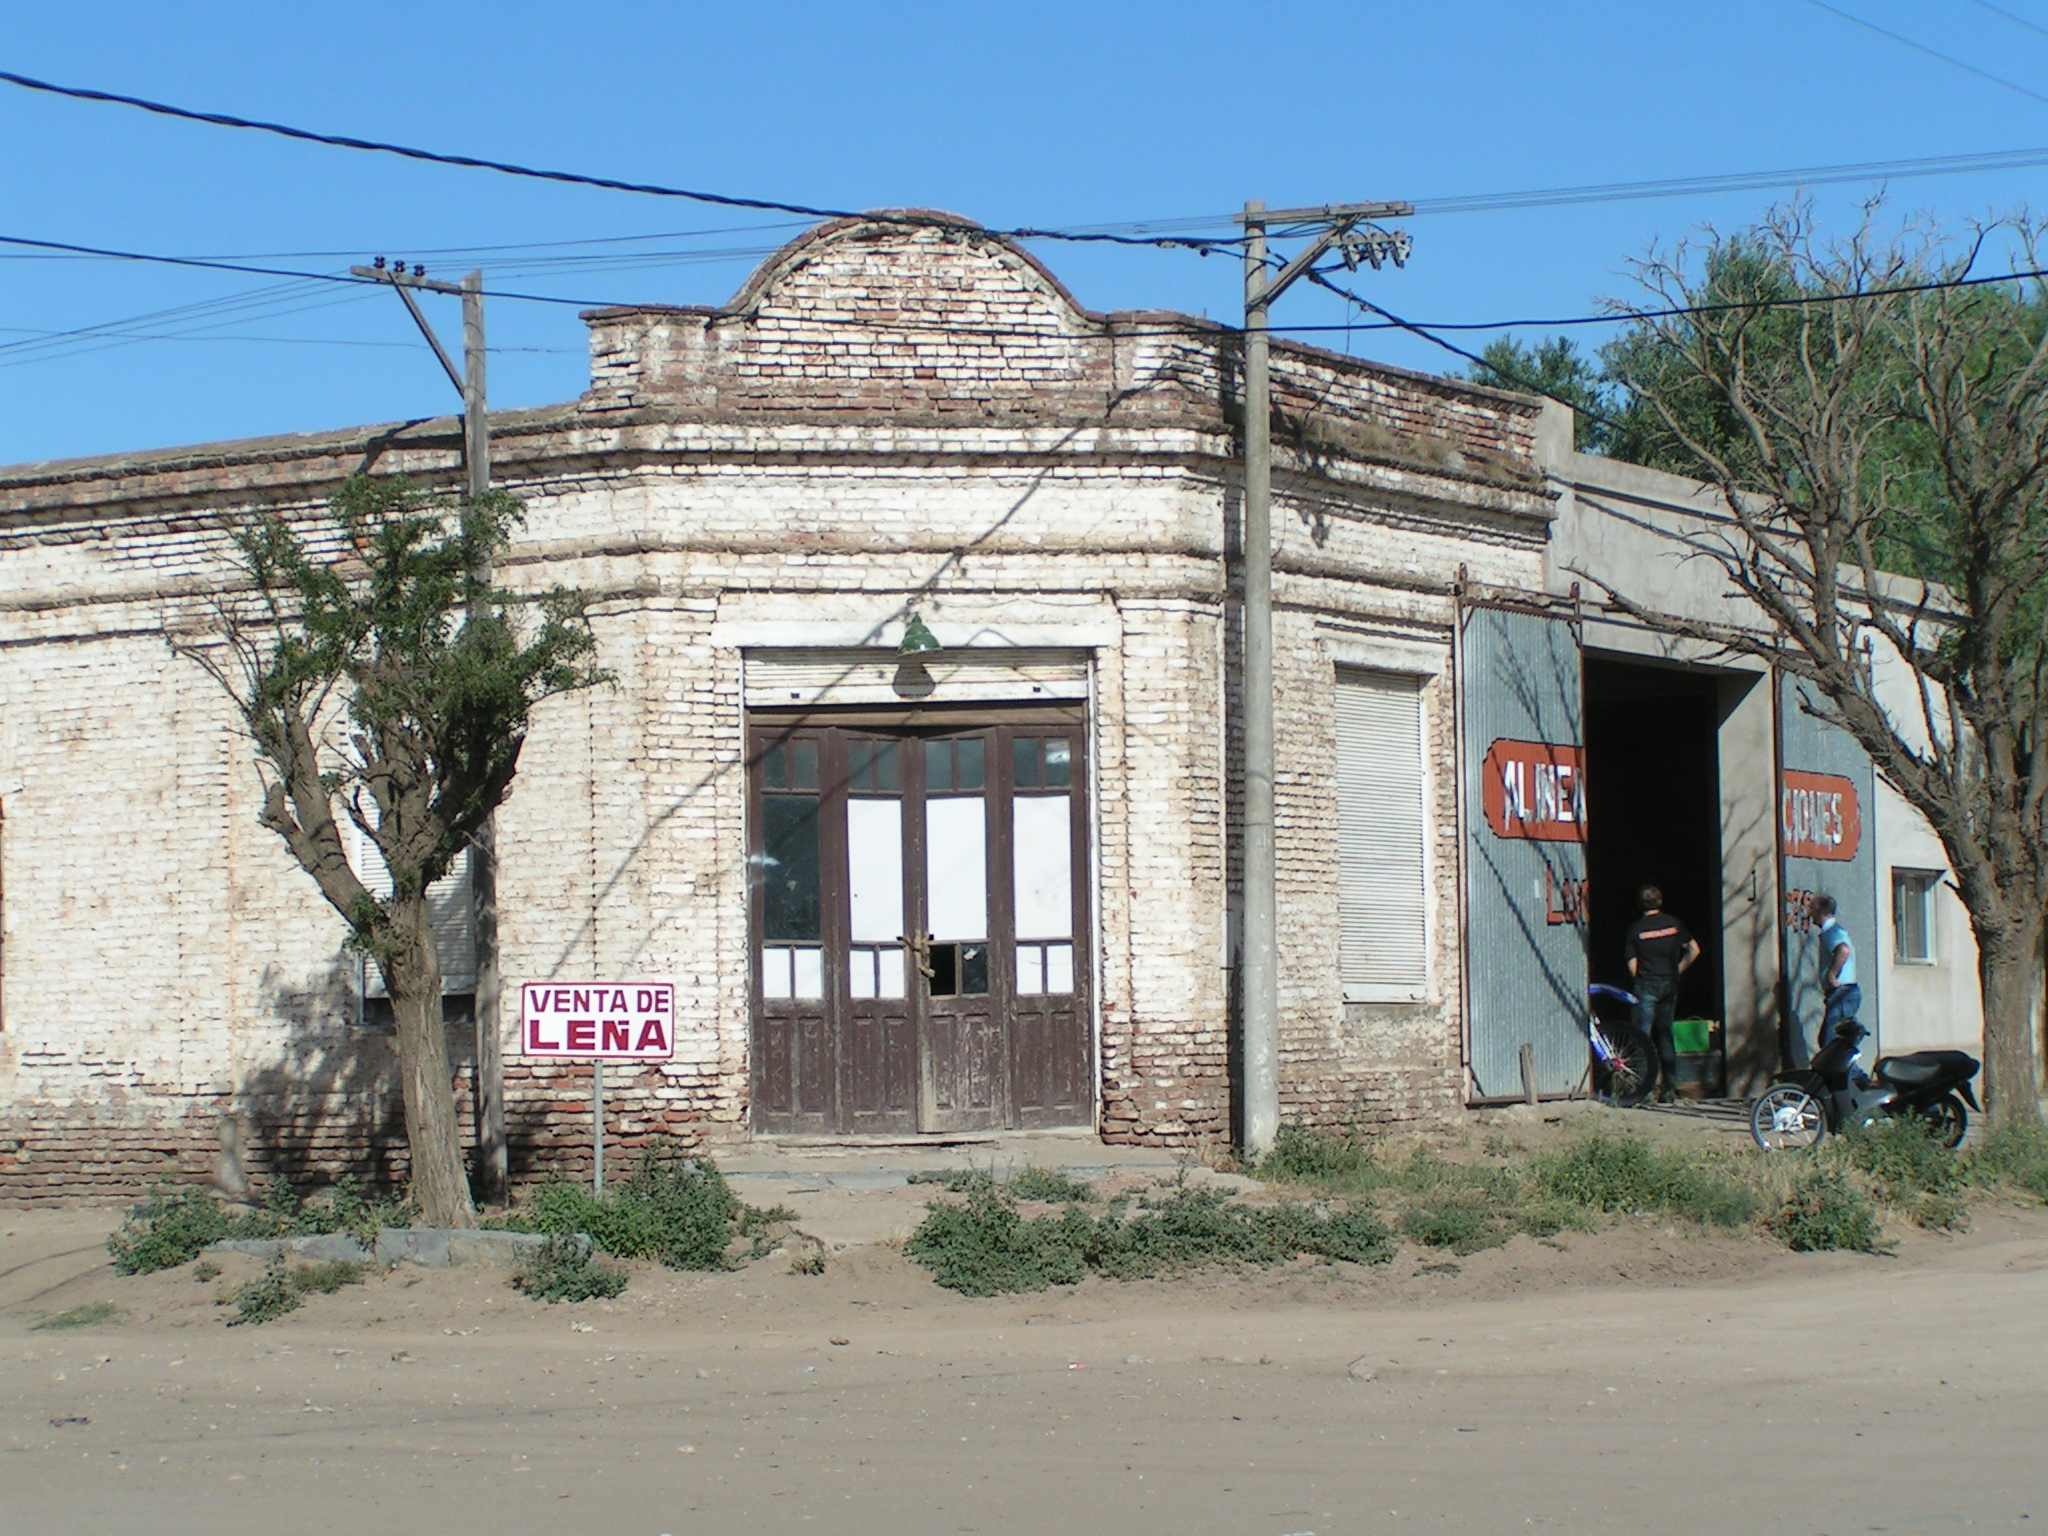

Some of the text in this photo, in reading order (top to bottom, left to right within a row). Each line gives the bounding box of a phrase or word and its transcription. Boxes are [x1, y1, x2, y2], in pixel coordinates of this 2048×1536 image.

[529, 989, 669, 1013] VENTA DE
[529, 1019, 668, 1051] LEÑA
